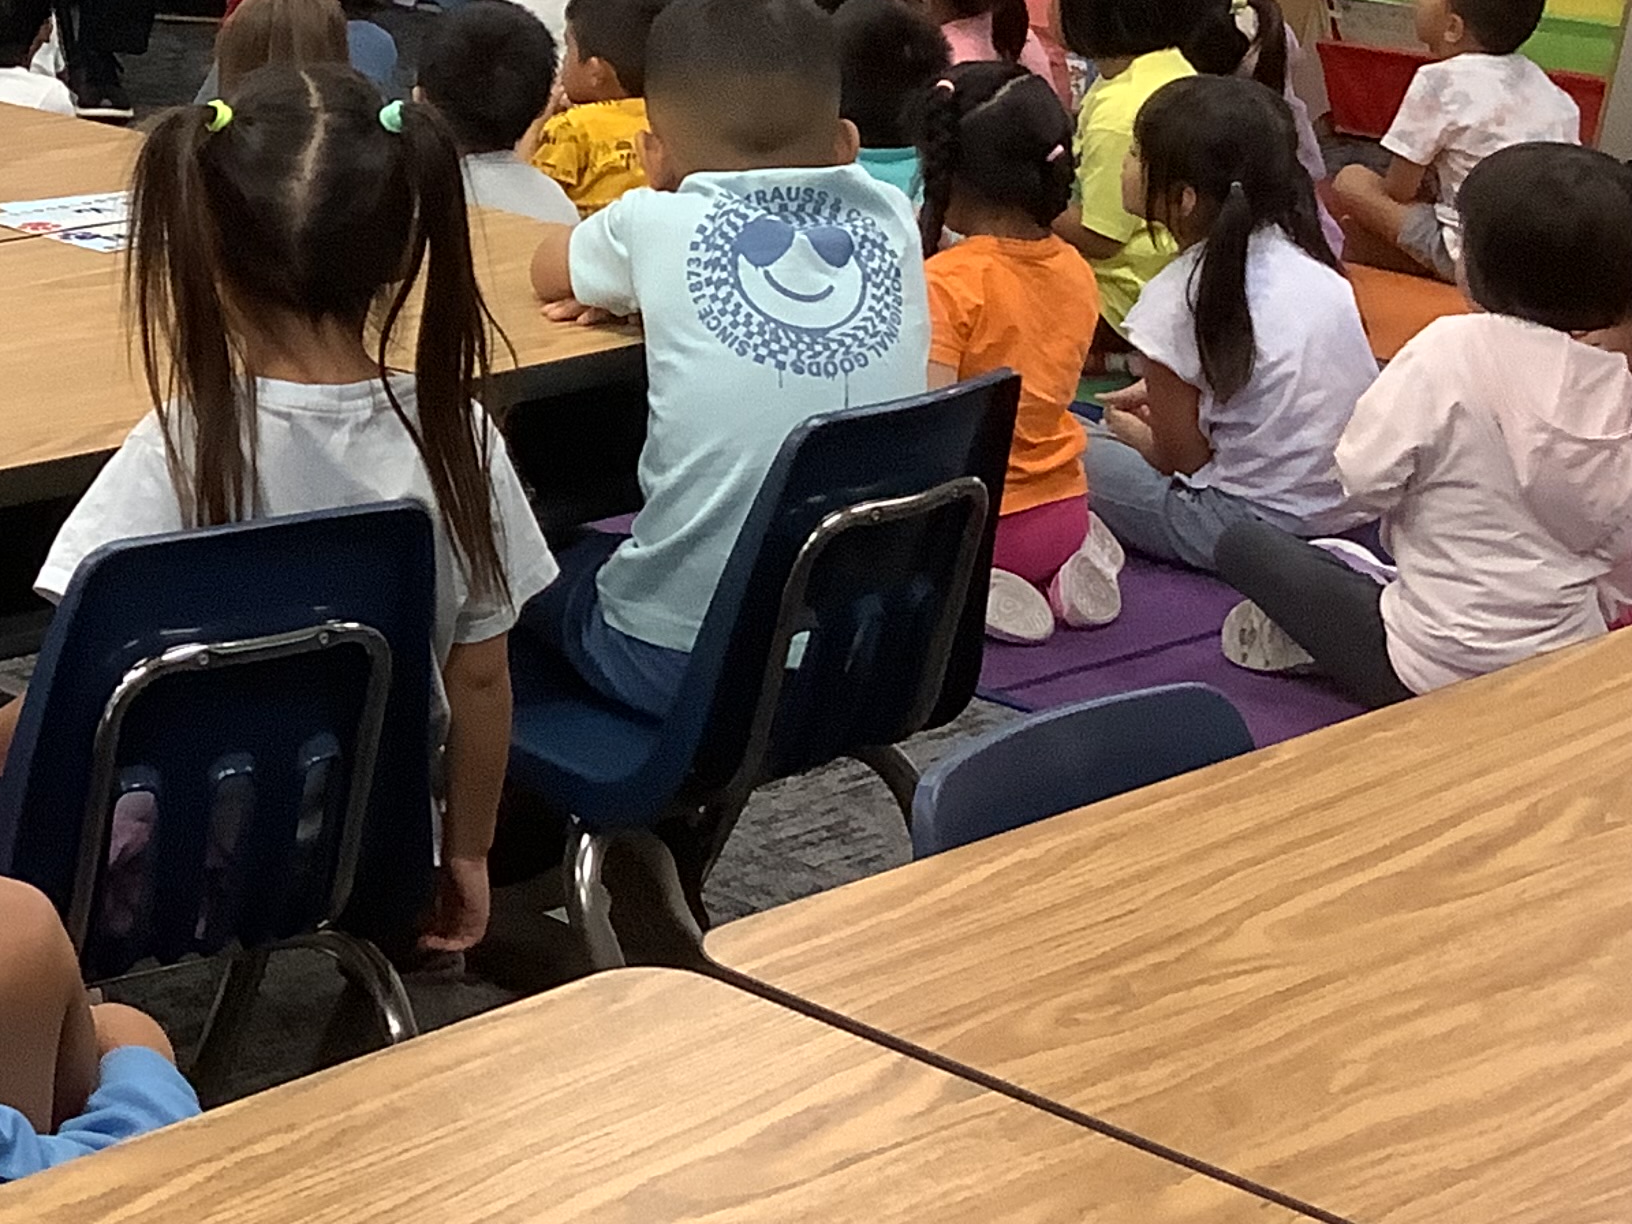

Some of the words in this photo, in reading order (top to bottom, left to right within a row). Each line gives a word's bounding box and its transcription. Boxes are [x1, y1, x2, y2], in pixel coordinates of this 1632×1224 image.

[830, 197, 843, 214] &
[686, 256, 706, 305] 1873
[698, 303, 752, 358] SINCE
[871, 277, 904, 359] ORIGINAL
[790, 351, 869, 378] GOODS
